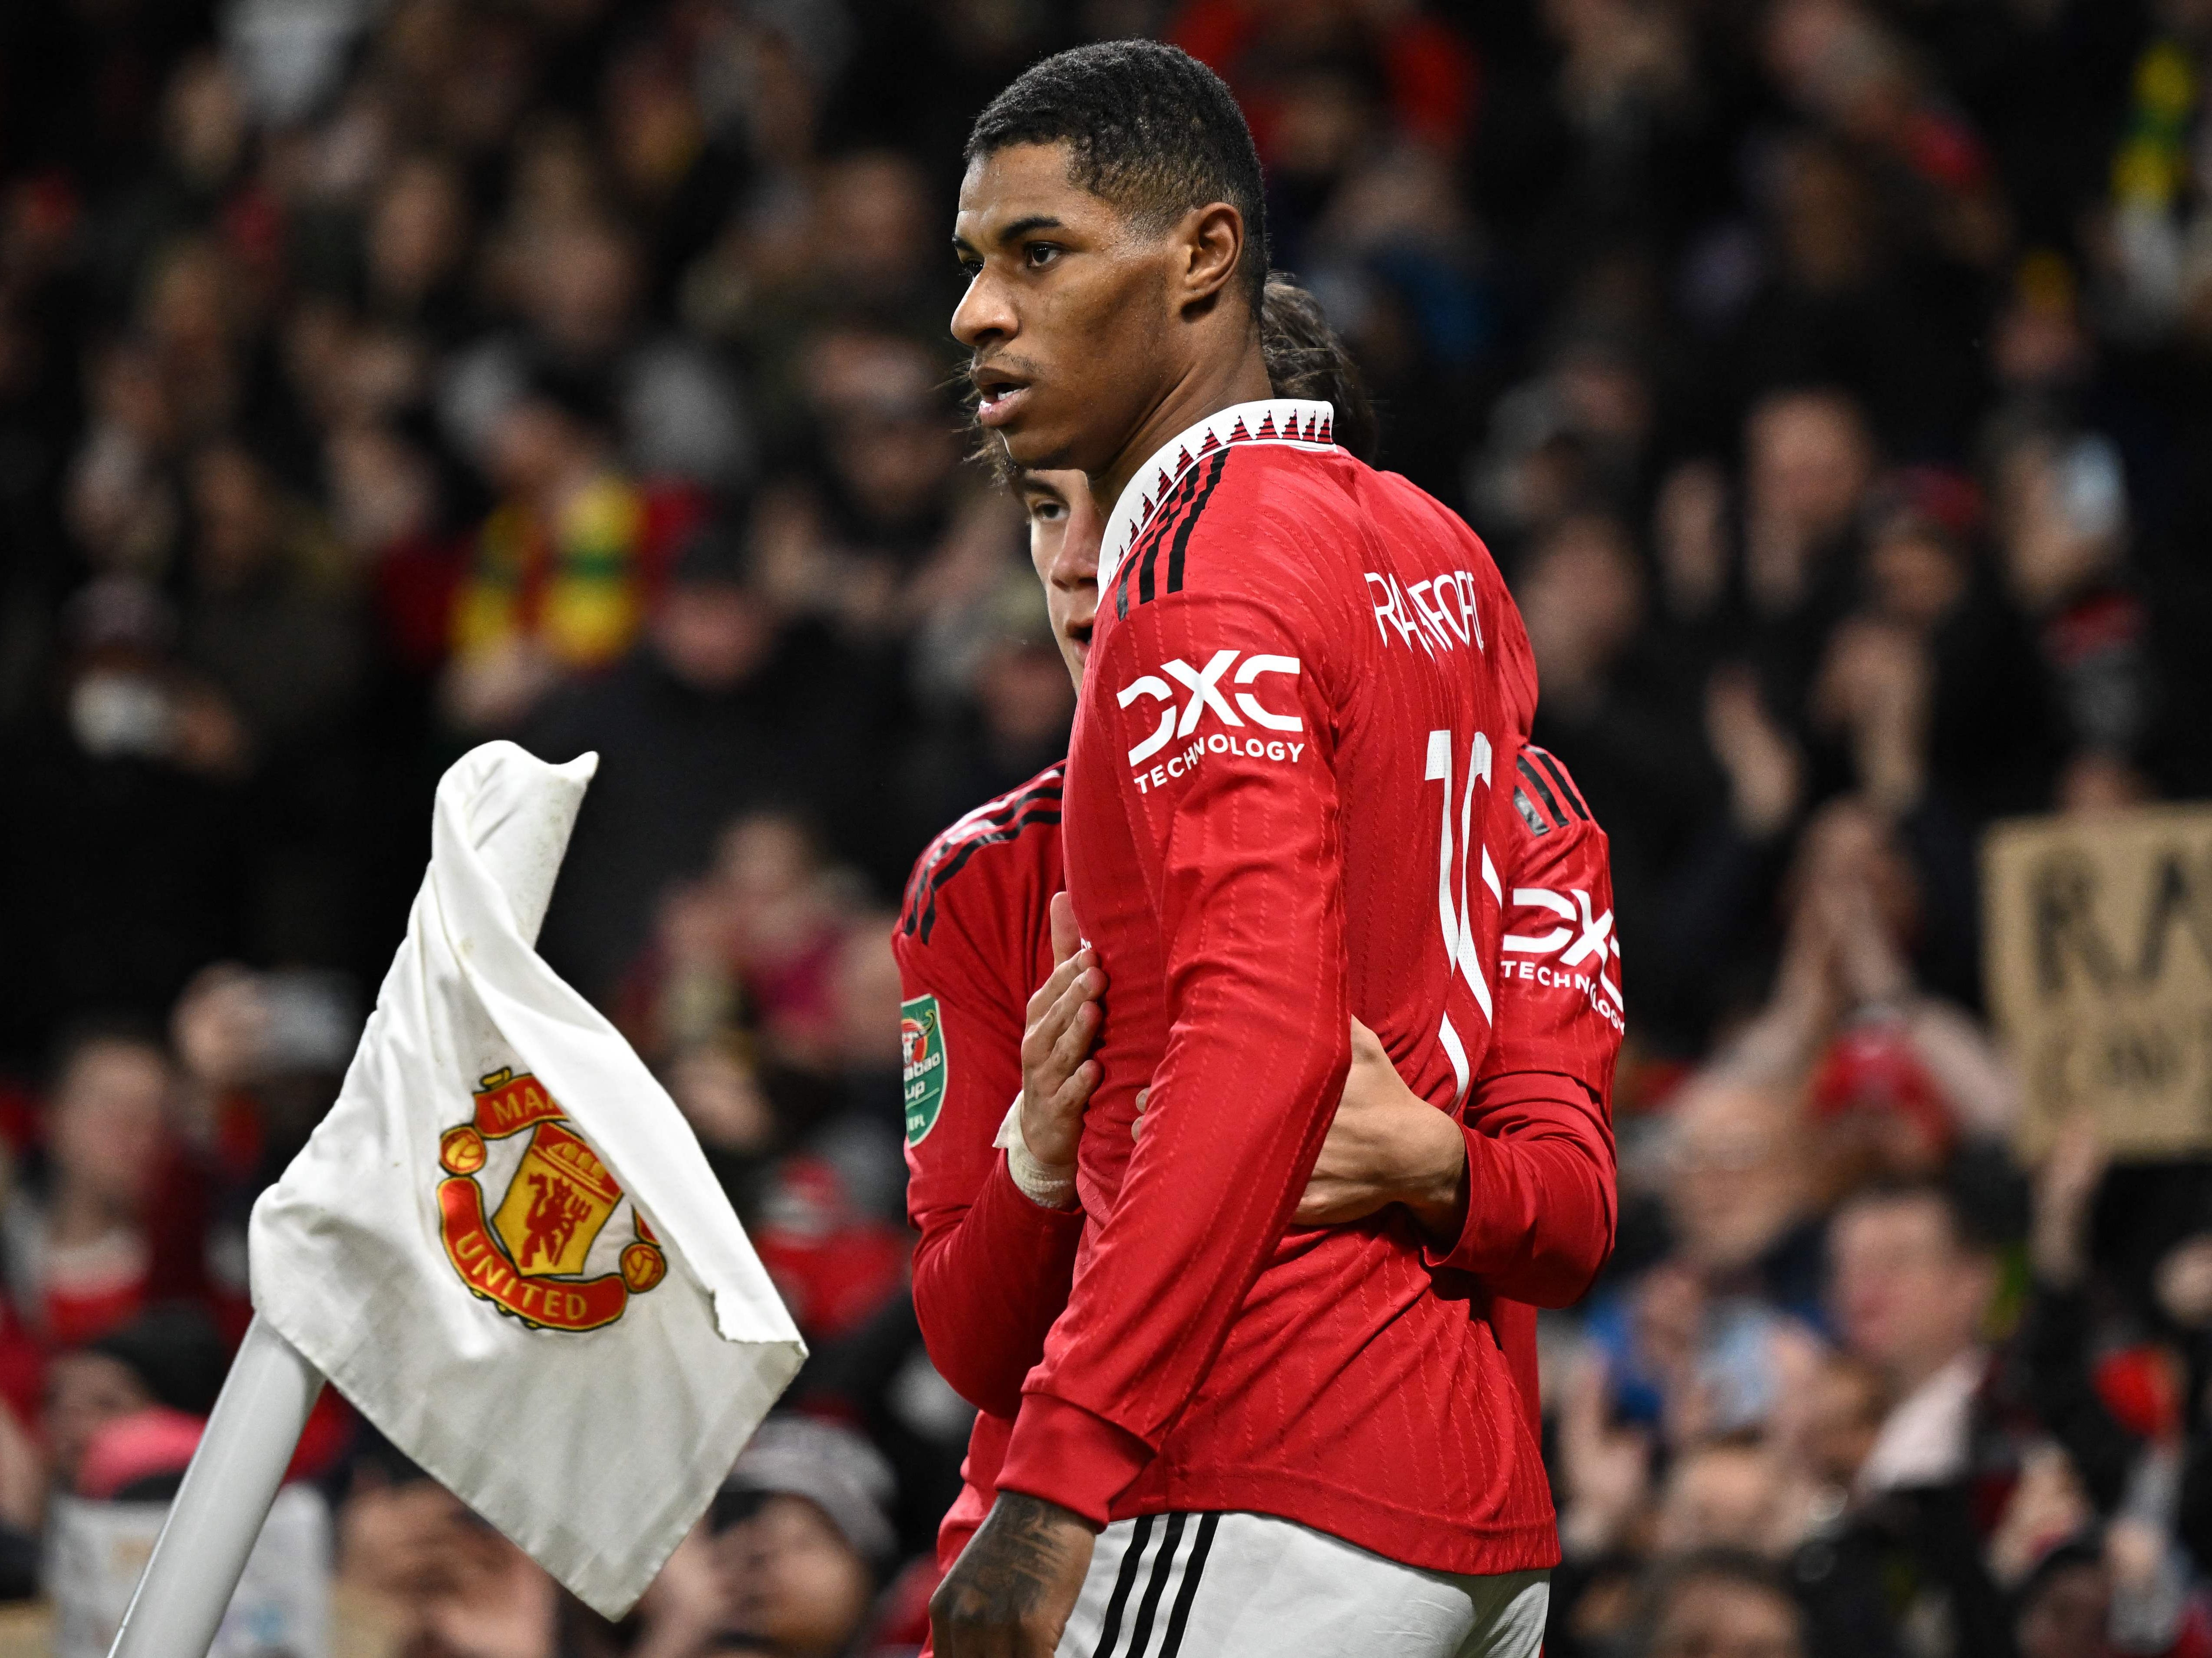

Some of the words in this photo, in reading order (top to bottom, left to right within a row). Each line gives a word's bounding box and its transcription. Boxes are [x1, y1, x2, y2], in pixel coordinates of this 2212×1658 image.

[1116, 650, 1303, 767] DXC
[1134, 734, 1305, 794] TECHNOLOGY
[905, 1081, 925, 1101] up
[456, 1229, 587, 1320] UNITED
